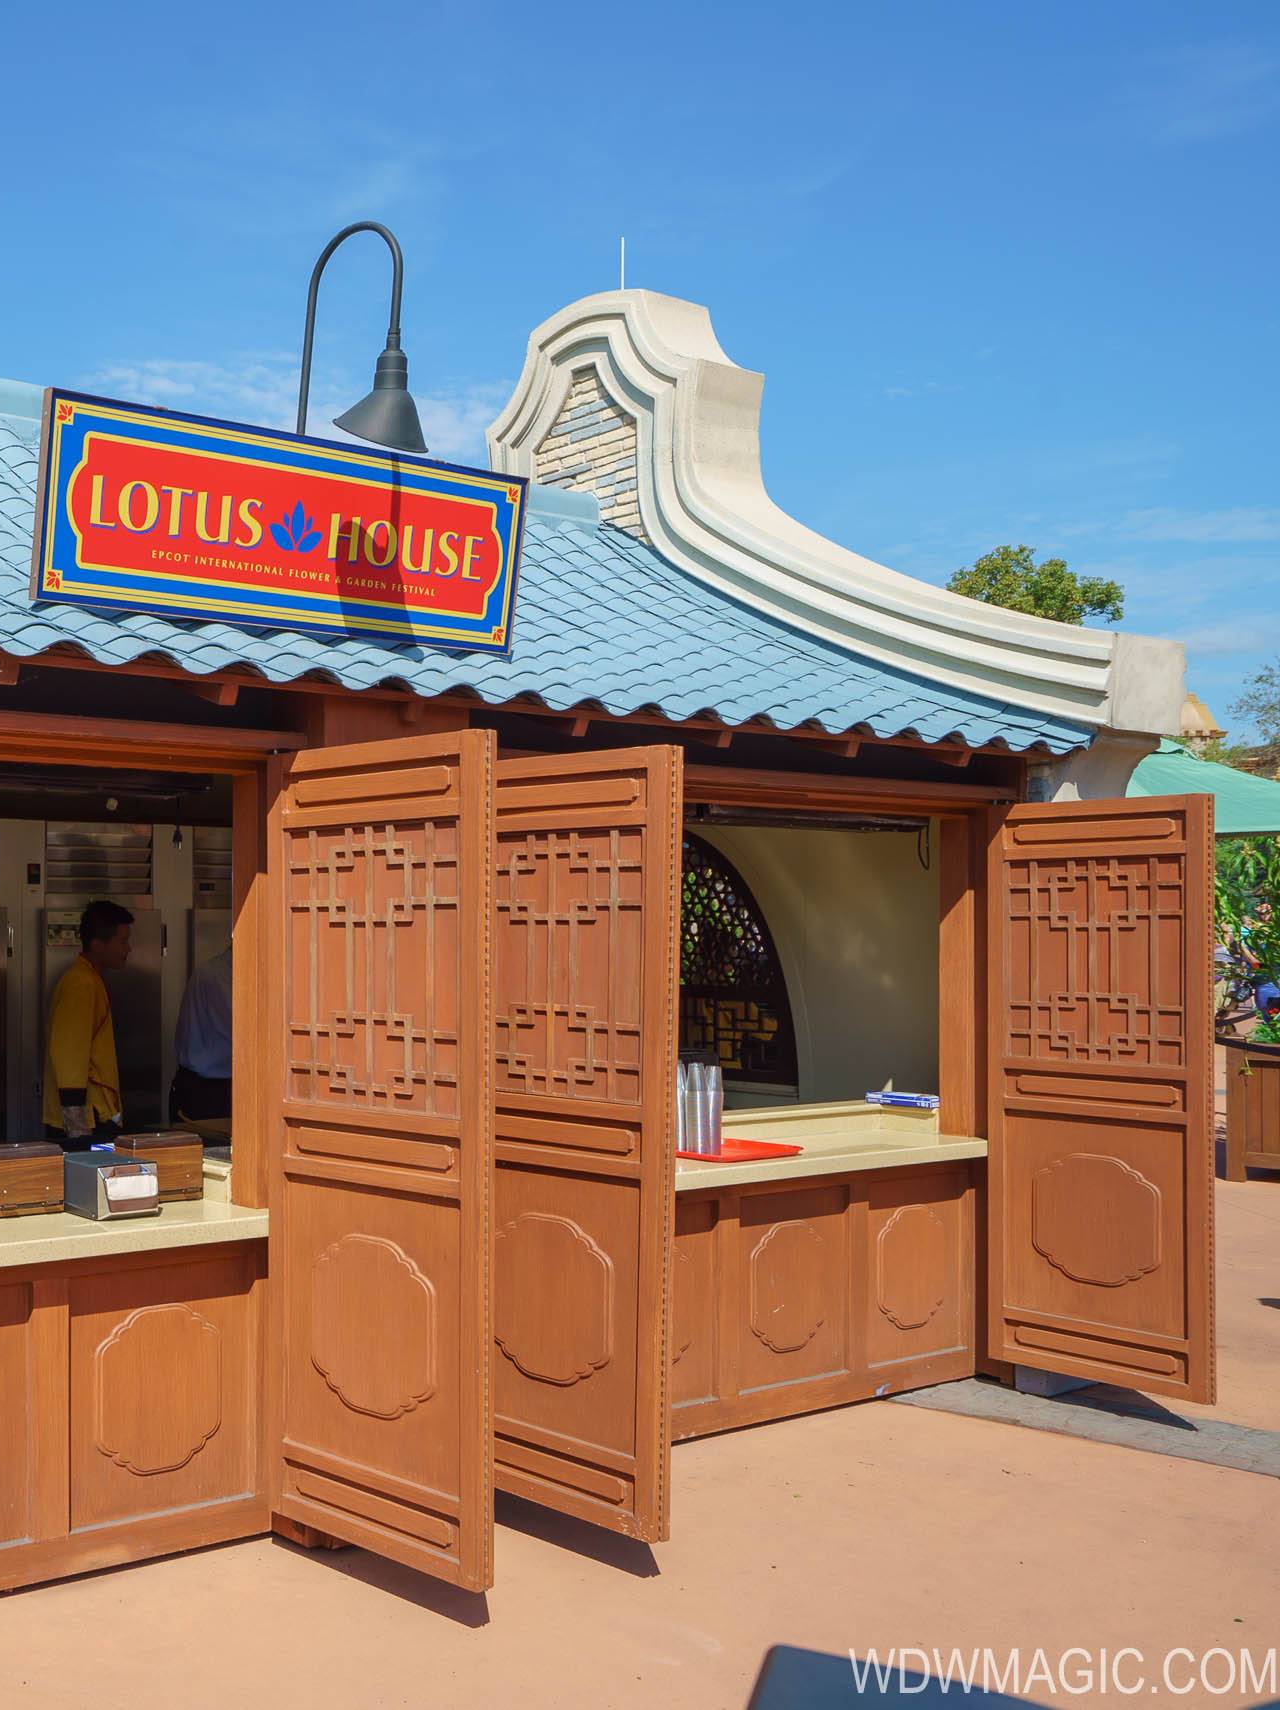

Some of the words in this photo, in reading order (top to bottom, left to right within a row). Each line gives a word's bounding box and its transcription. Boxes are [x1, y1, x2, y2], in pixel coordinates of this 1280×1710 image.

[89, 474, 264, 549] LOTUS
[327, 512, 484, 582] HOUSE
[151, 549, 191, 563] EPCOT
[194, 555, 284, 577] INTERNATIONAL
[289, 568, 331, 584] FLOWER
[346, 576, 387, 590] GARDEN
[391, 583, 436, 597] FESTIVAL
